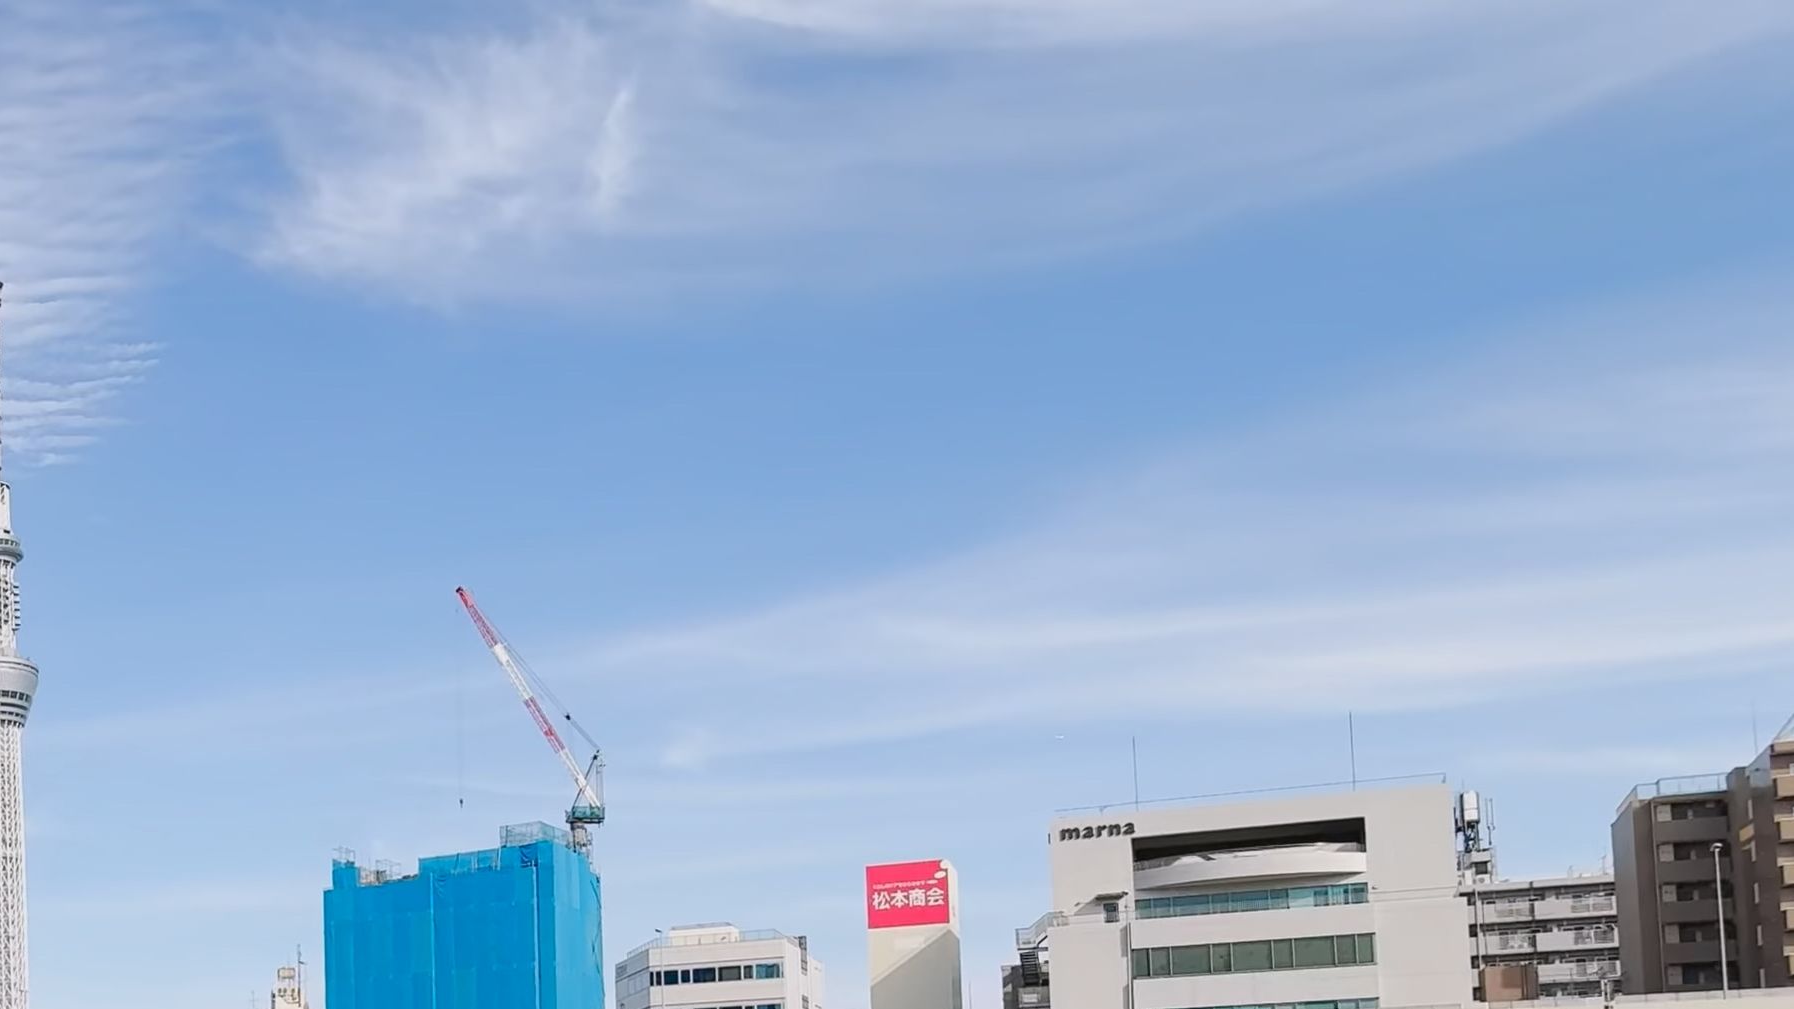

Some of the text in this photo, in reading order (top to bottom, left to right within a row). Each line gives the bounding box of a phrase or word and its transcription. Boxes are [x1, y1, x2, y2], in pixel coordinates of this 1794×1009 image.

[1059, 822, 1135, 841] marna
[872, 887, 945, 910] 松本商会
